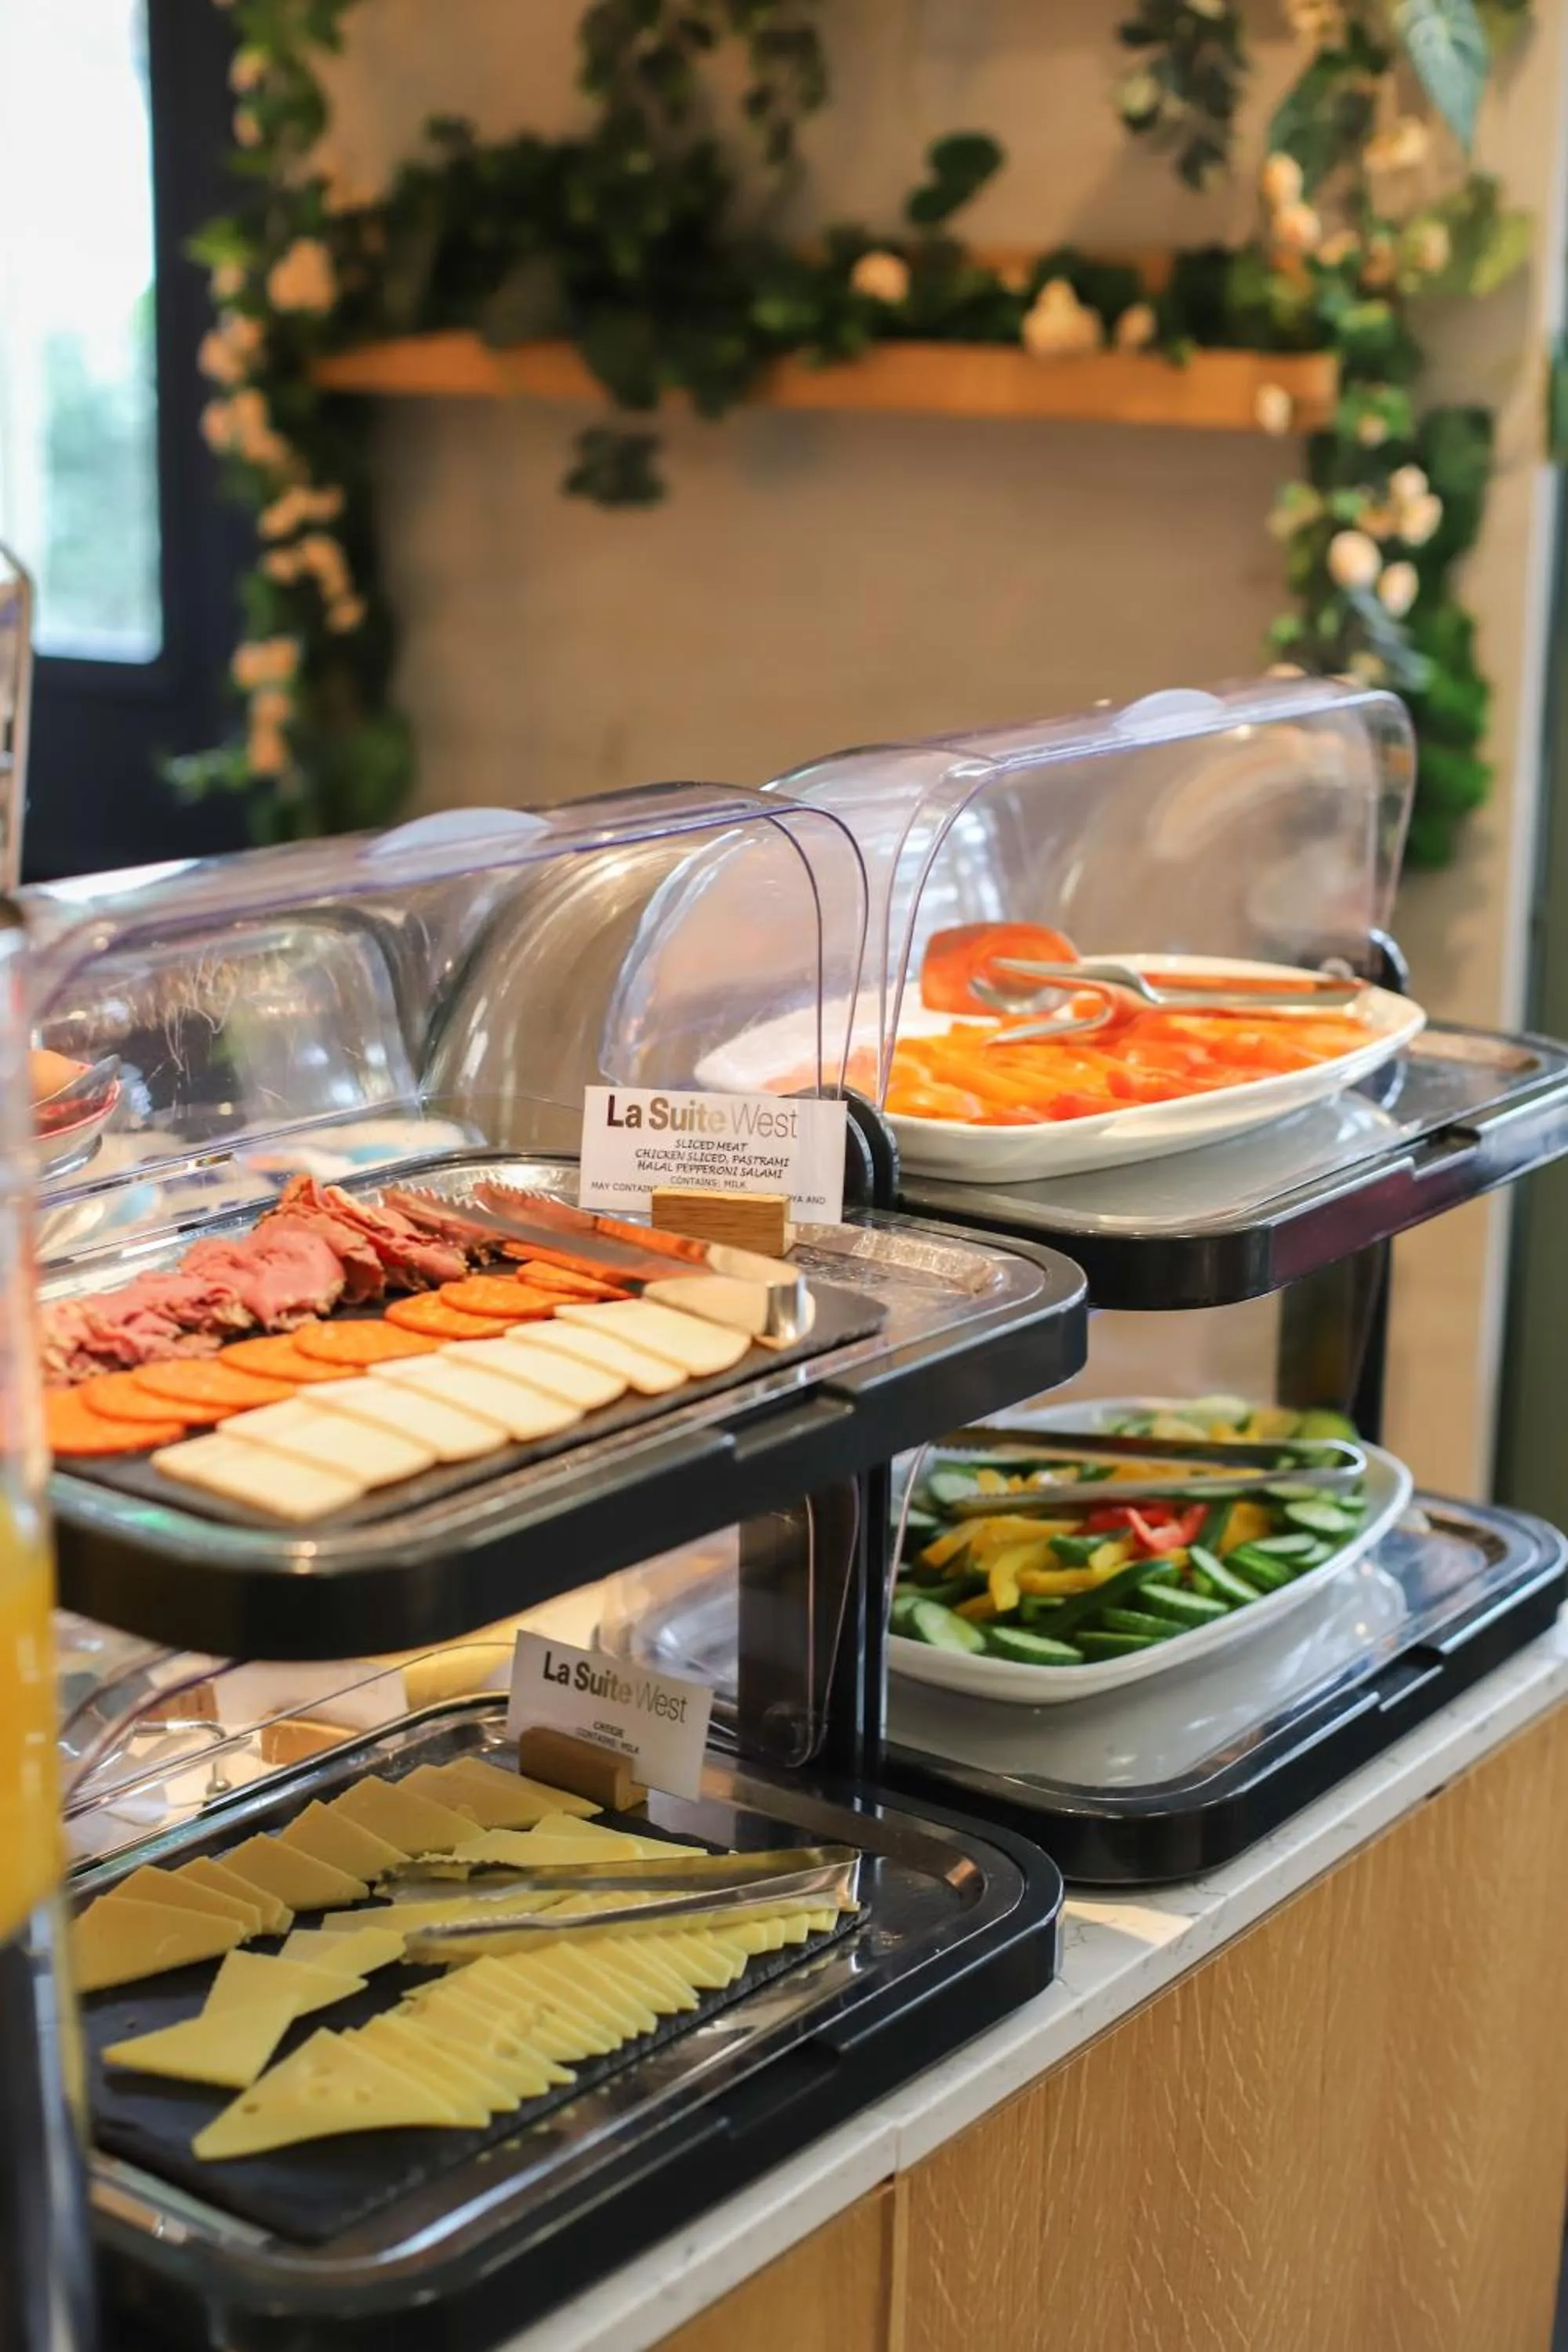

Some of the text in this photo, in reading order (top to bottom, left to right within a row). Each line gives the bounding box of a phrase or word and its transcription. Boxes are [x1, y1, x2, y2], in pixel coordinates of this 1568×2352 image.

[607, 1094, 797, 1138] La Suite West
[676, 1138, 748, 1152] SLICED MEAT
[635, 1149, 684, 1161] CHICKEN
[732, 1155, 789, 1167] PASTRAMI
[637, 1160, 782, 1179] HALAL PEPPERONI SALAMI
[591, 1181, 609, 1190] MAY
[806, 1196, 826, 1205] AND
[724, 1180, 746, 1189] MILK
[543, 1651, 688, 1723] La Suite West
